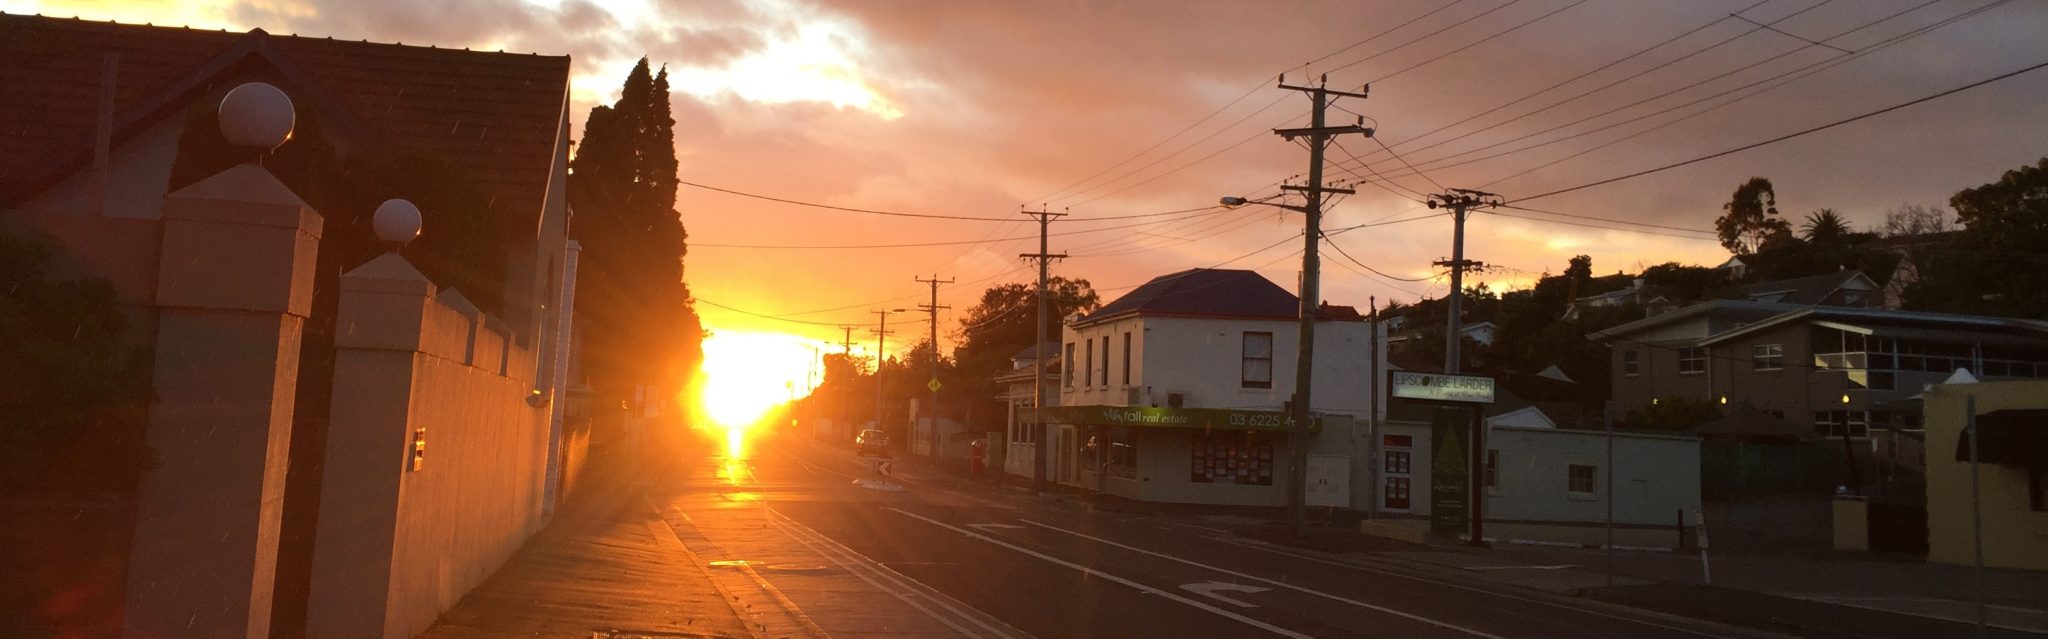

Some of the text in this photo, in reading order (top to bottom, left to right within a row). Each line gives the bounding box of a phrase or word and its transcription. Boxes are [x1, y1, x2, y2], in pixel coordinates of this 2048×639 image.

[1395, 374, 1493, 389] LIPSCOMBE LARDER
[1124, 410, 1188, 425] fall real estate
[1230, 413, 1246, 425] 03
[1250, 415, 1281, 427] 6225
